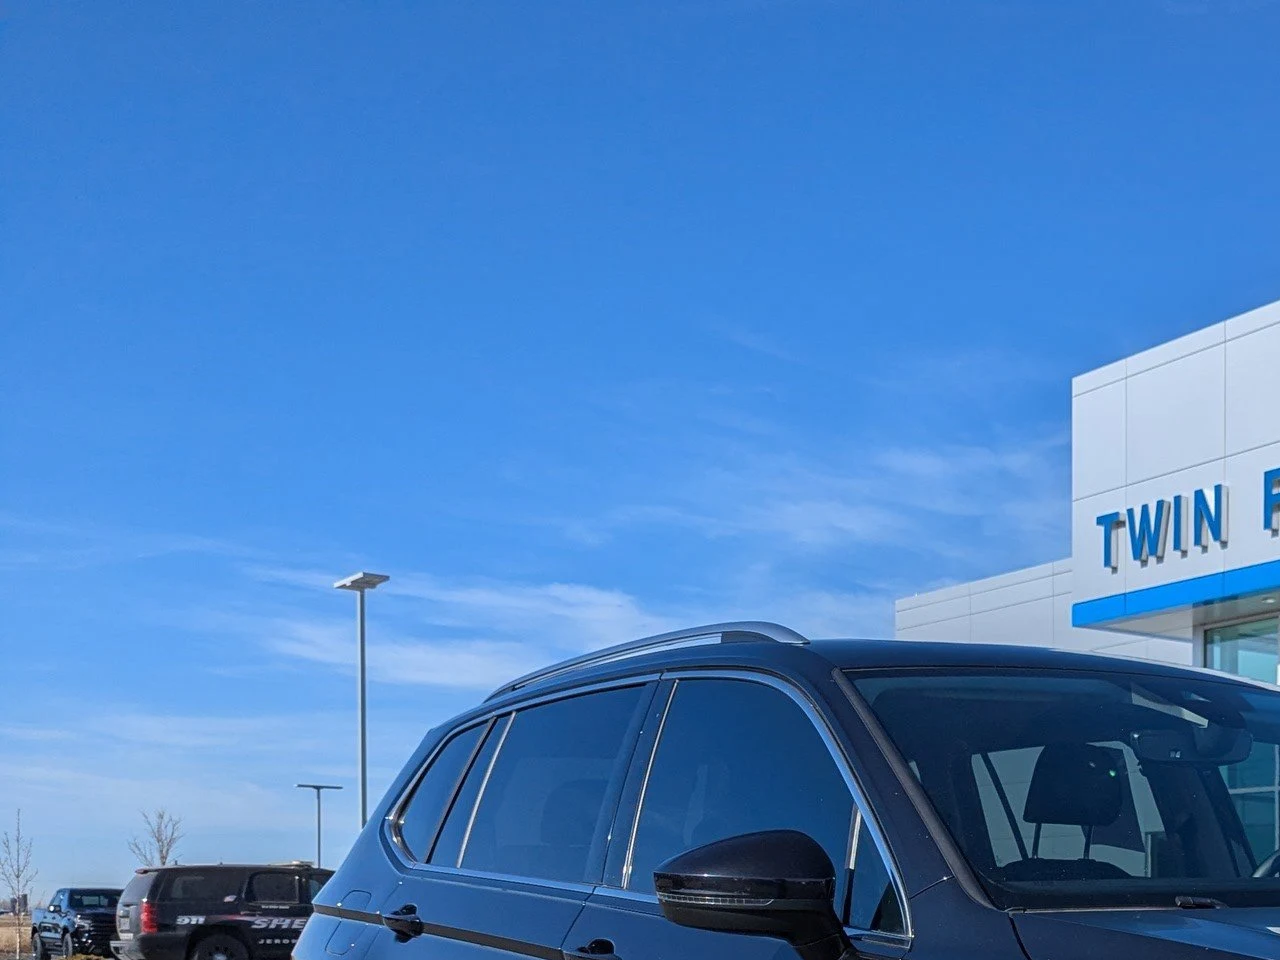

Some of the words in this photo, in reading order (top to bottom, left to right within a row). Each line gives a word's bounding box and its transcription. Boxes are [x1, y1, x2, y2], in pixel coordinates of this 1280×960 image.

[1096, 483, 1228, 570] TWIN
[175, 915, 206, 925] 911
[251, 918, 307, 929] SHE
